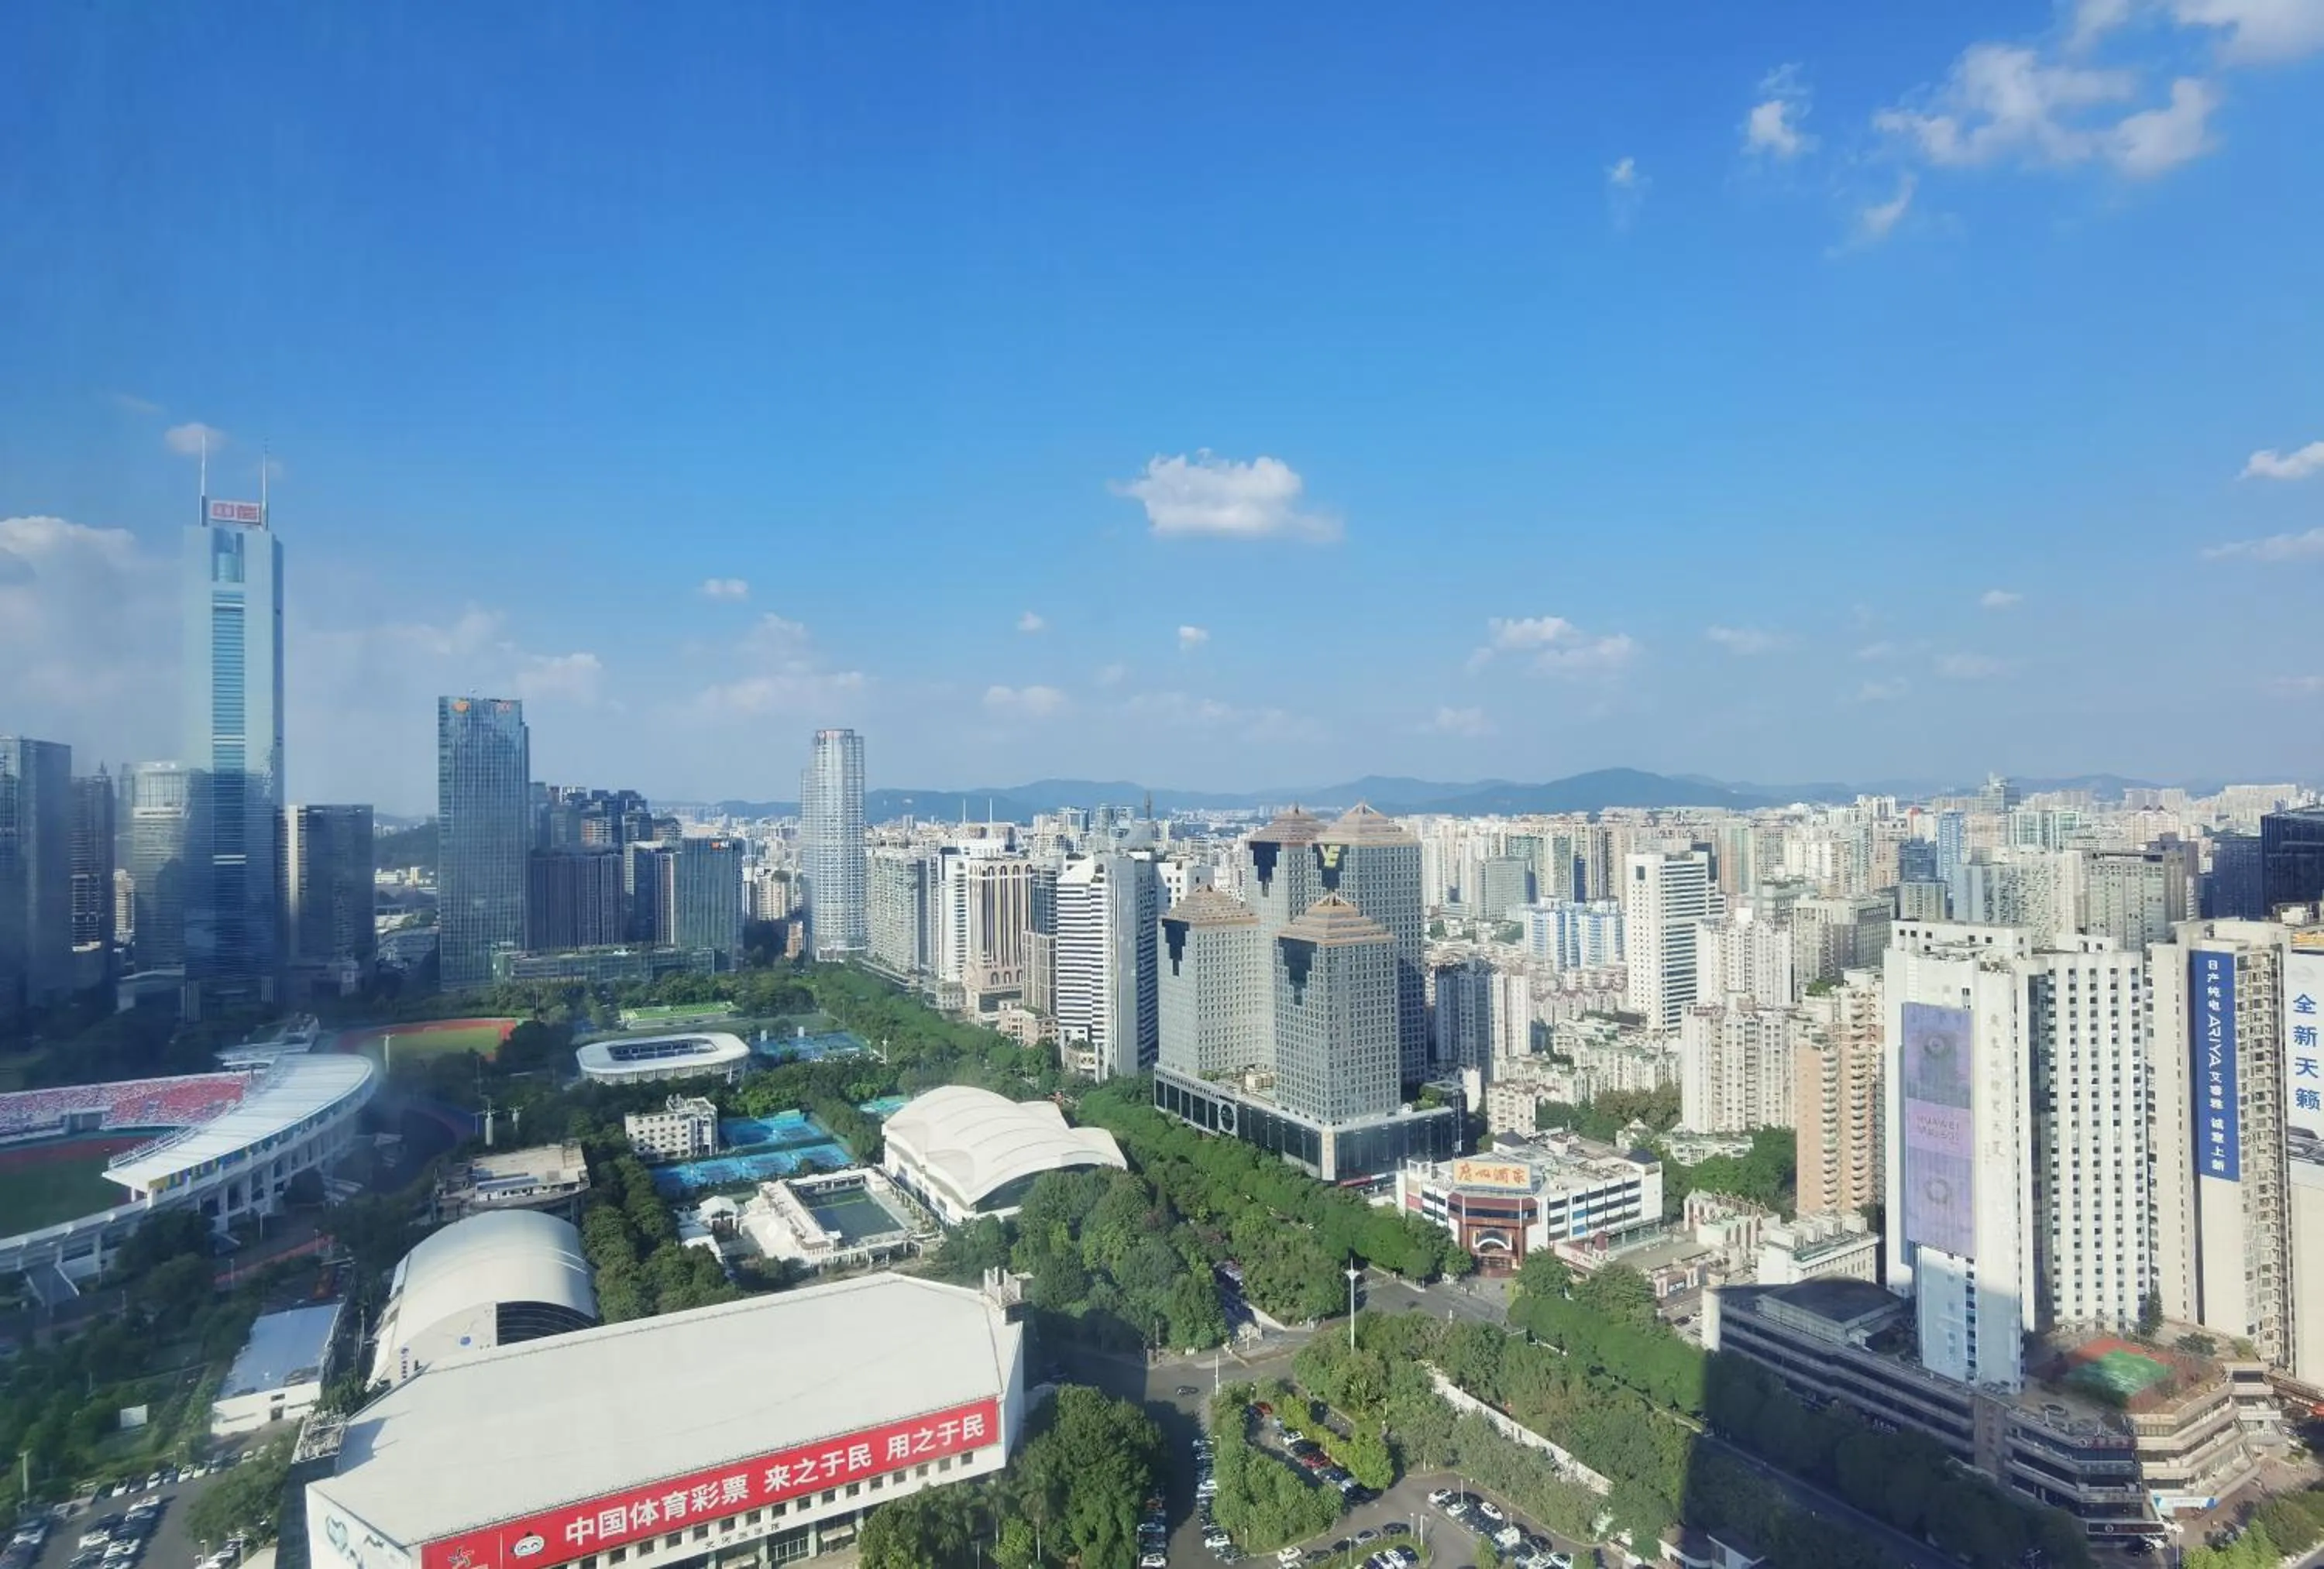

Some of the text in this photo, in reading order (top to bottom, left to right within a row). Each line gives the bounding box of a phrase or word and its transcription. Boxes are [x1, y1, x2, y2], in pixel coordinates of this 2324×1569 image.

[2292, 994, 2322, 1111] 全新天籁
[566, 1474, 749, 1547] 中国体育彩票
[764, 1443, 872, 1493] 来之于民
[885, 1413, 985, 1462] 用之于民
